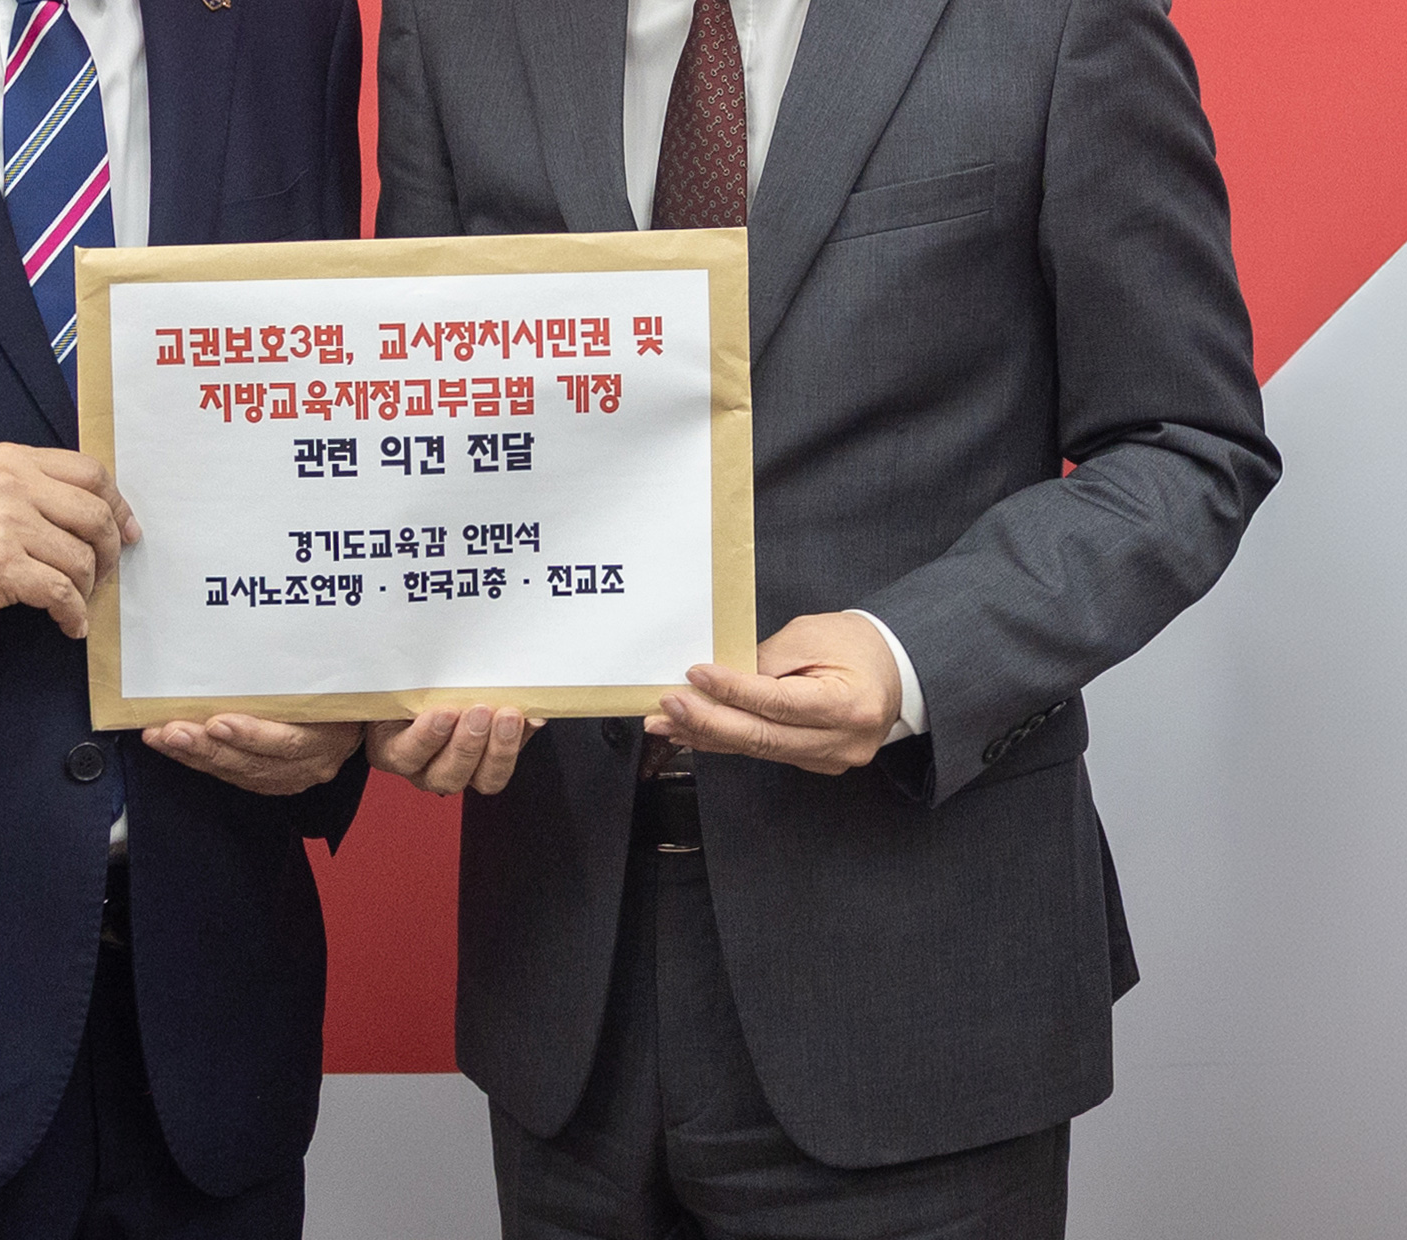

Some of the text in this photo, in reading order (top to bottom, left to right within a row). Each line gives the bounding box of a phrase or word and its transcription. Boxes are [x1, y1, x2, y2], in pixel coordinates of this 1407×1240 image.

[156, 316, 665, 368] 교권보호3법, 교사정치시민권 및
[200, 374, 623, 425] 지방교육재정교부금법 개정
[294, 431, 536, 480] 관련 의견 전달
[289, 522, 542, 565] 경기도교육감 안민석
[205, 564, 626, 609] 교사노조연맹 한국교총 전교조
